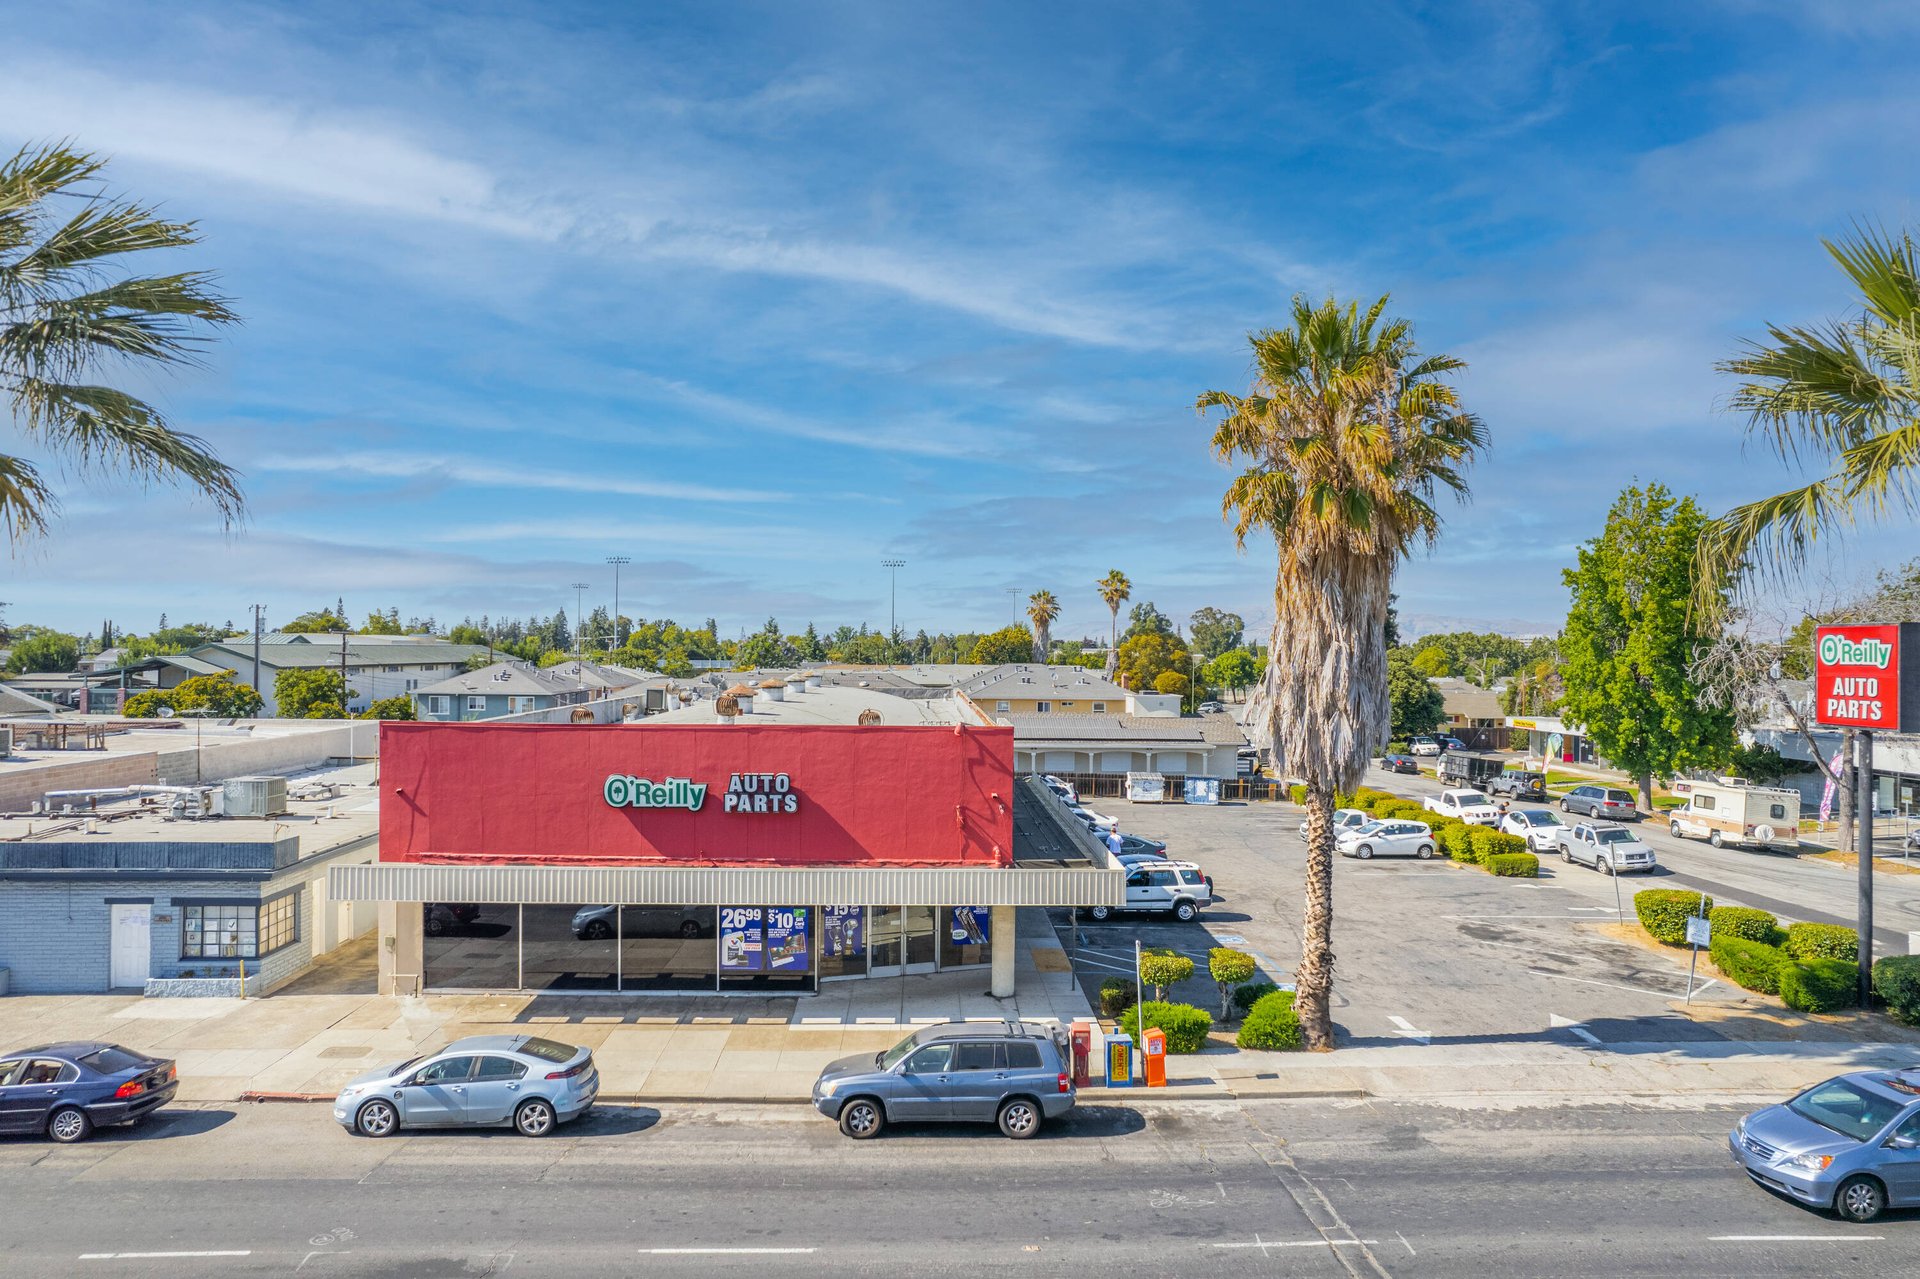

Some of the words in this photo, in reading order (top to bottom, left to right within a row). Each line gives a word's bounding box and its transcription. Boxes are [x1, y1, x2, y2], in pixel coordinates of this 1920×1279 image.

[1821, 636, 1889, 667] O'Reilly
[1832, 677, 1878, 698] AUTO
[1827, 698, 1882, 721] PARTS
[606, 777, 705, 810] O'Reilly
[729, 773, 790, 793] AUTO
[724, 793, 798, 813] PARTS
[768, 912, 794, 929] $10
